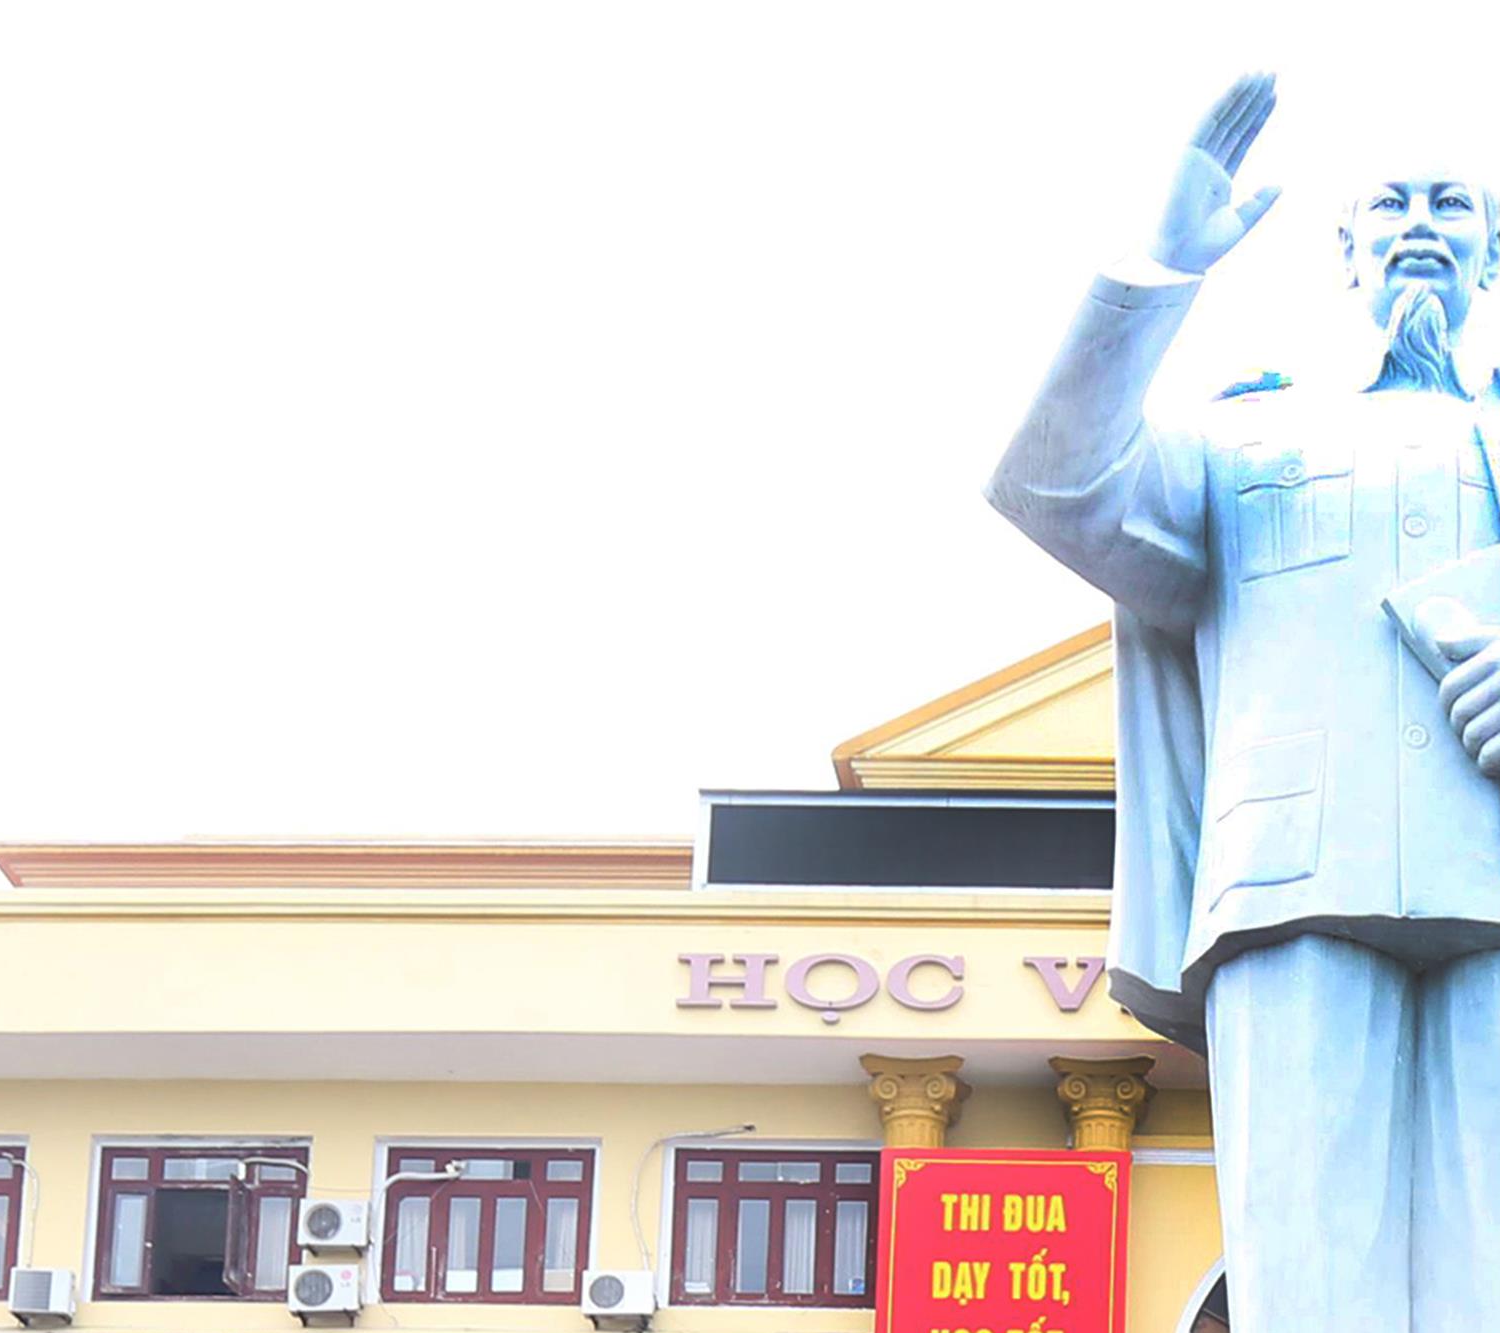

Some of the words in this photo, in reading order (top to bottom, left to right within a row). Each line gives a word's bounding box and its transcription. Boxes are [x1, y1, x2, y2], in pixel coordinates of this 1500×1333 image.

[676, 953, 965, 1025] HỌC
[940, 1193, 992, 1232] THI
[1003, 1195, 1067, 1232] ĐUA
[931, 1261, 991, 1306] DẠY
[1008, 1248, 1070, 1306] TỐT,
